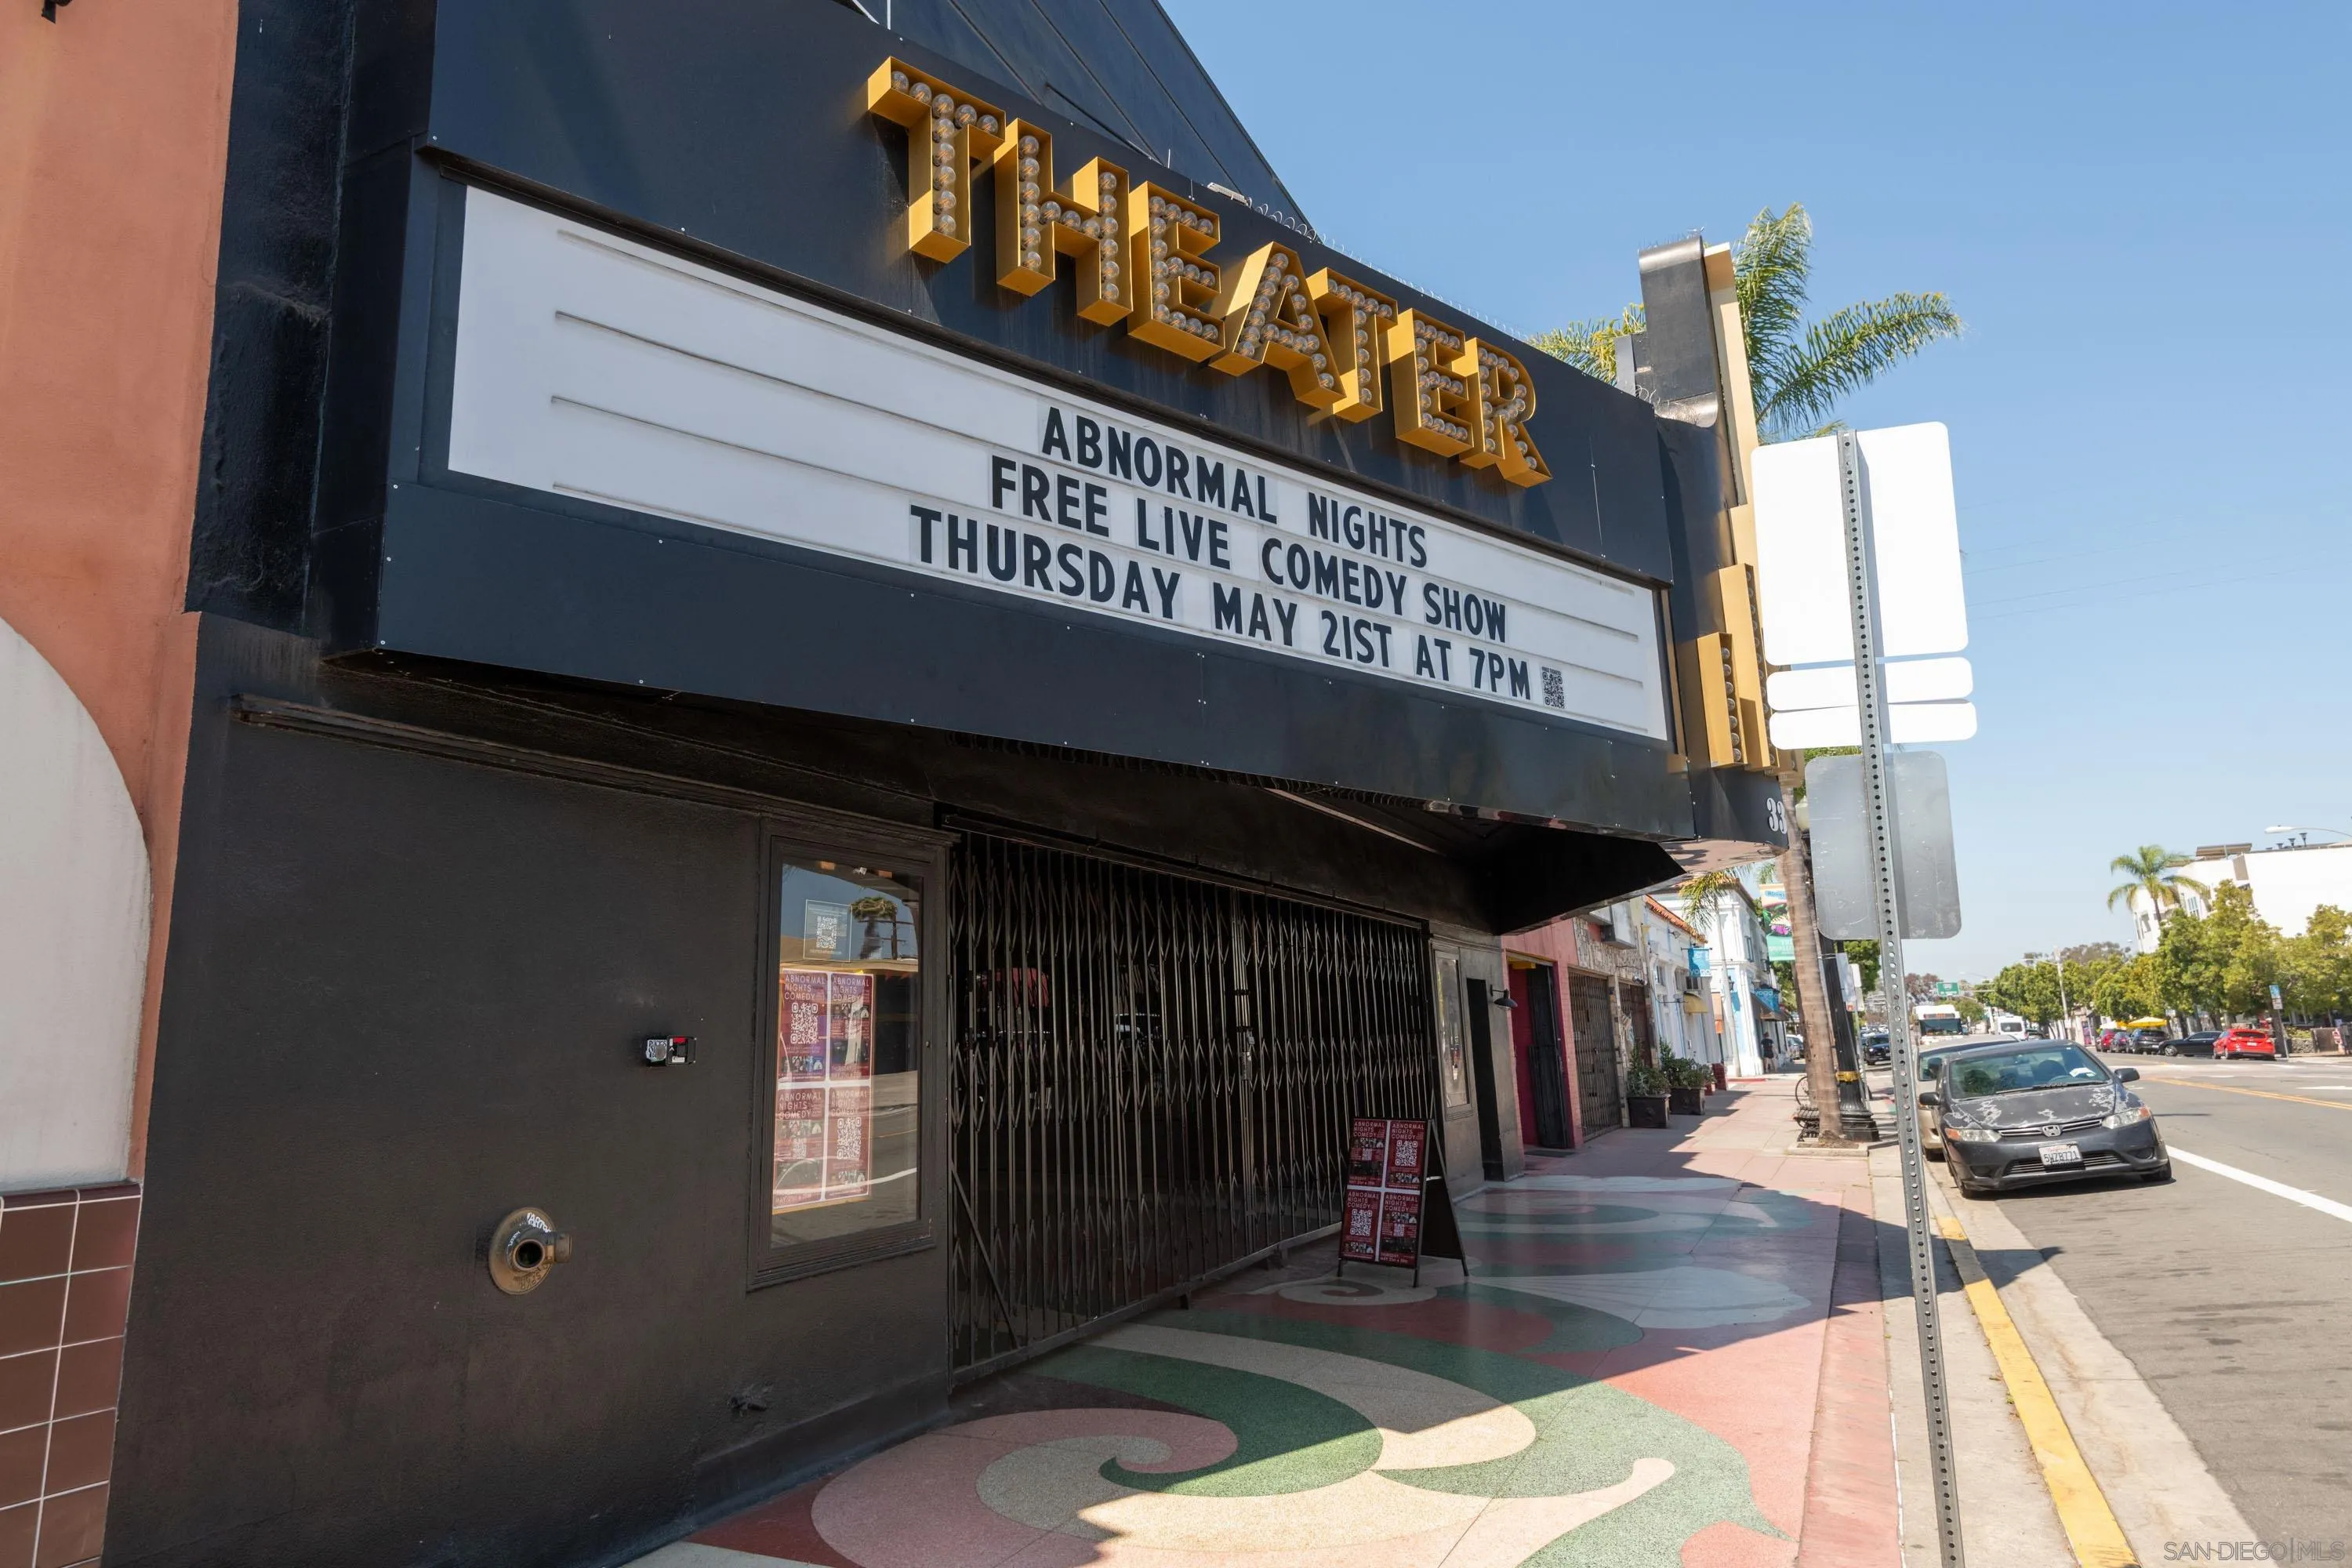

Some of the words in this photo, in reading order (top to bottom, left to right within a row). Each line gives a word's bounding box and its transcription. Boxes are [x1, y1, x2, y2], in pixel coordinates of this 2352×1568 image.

[868, 56, 1552, 488] THEATER
[1042, 408, 1277, 524] ABNORMAL
[1308, 492, 1427, 568] NIGHTS
[991, 456, 1109, 537] FREE
[1137, 498, 1231, 570] LIVE
[1262, 537, 1407, 616] COMEDY
[1425, 582, 1507, 643] SHOW
[910, 505, 1181, 619] THURSDAY
[1214, 582, 1298, 647] MAY
[1322, 610, 1392, 667] 21ST
[1416, 634, 1451, 681] AT
[1470, 648, 1530, 700] 7PM
[785, 975, 826, 985] ABNORMAL
[833, 978, 869, 986] ABNORMAL
[785, 983, 811, 992] NIGHTS
[779, 1092, 822, 1101] ABNORMAL
[779, 1102, 808, 1110] NIGHTS
